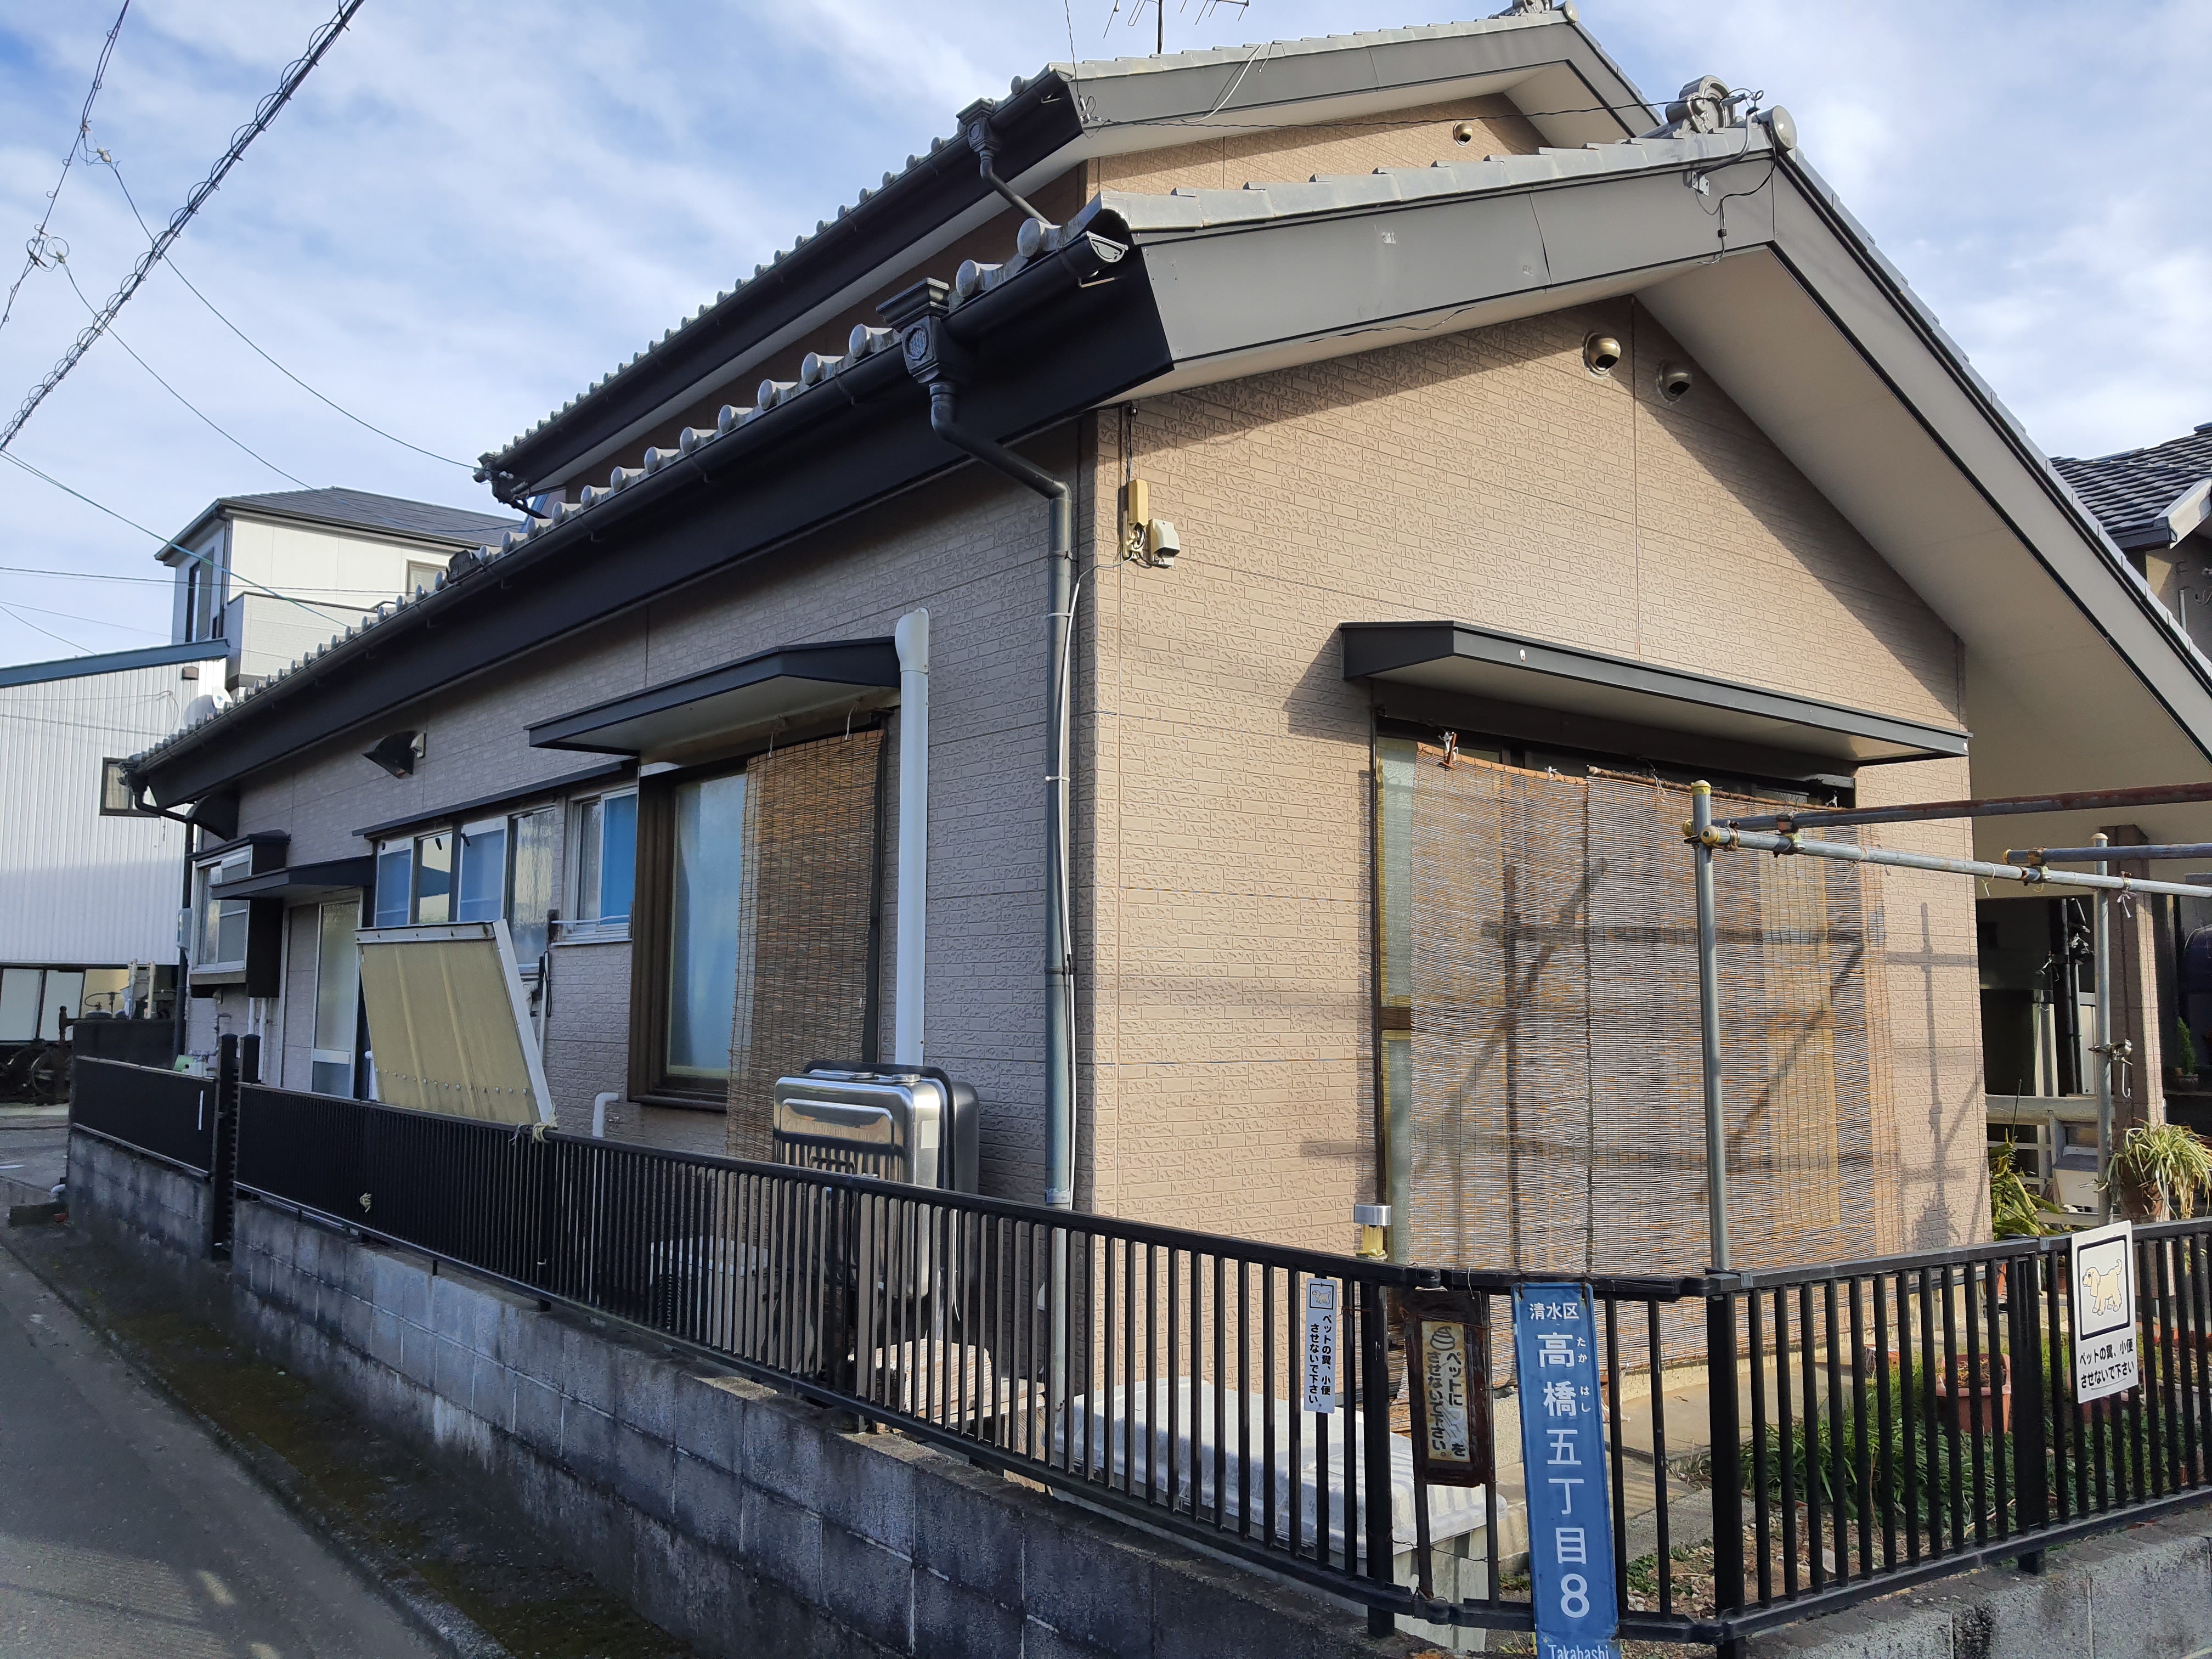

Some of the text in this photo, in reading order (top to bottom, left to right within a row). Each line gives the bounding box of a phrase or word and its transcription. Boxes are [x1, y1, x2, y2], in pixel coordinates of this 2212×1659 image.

[1529, 1302, 1579, 1321] 清水区
[1308, 1323, 1320, 1404] させないで下さい
[2080, 1361, 2135, 1389] させないで下さい
[1537, 1332, 1590, 1618] 高橋五丁目8
[1548, 1645, 1610, 1659] Takahashi
